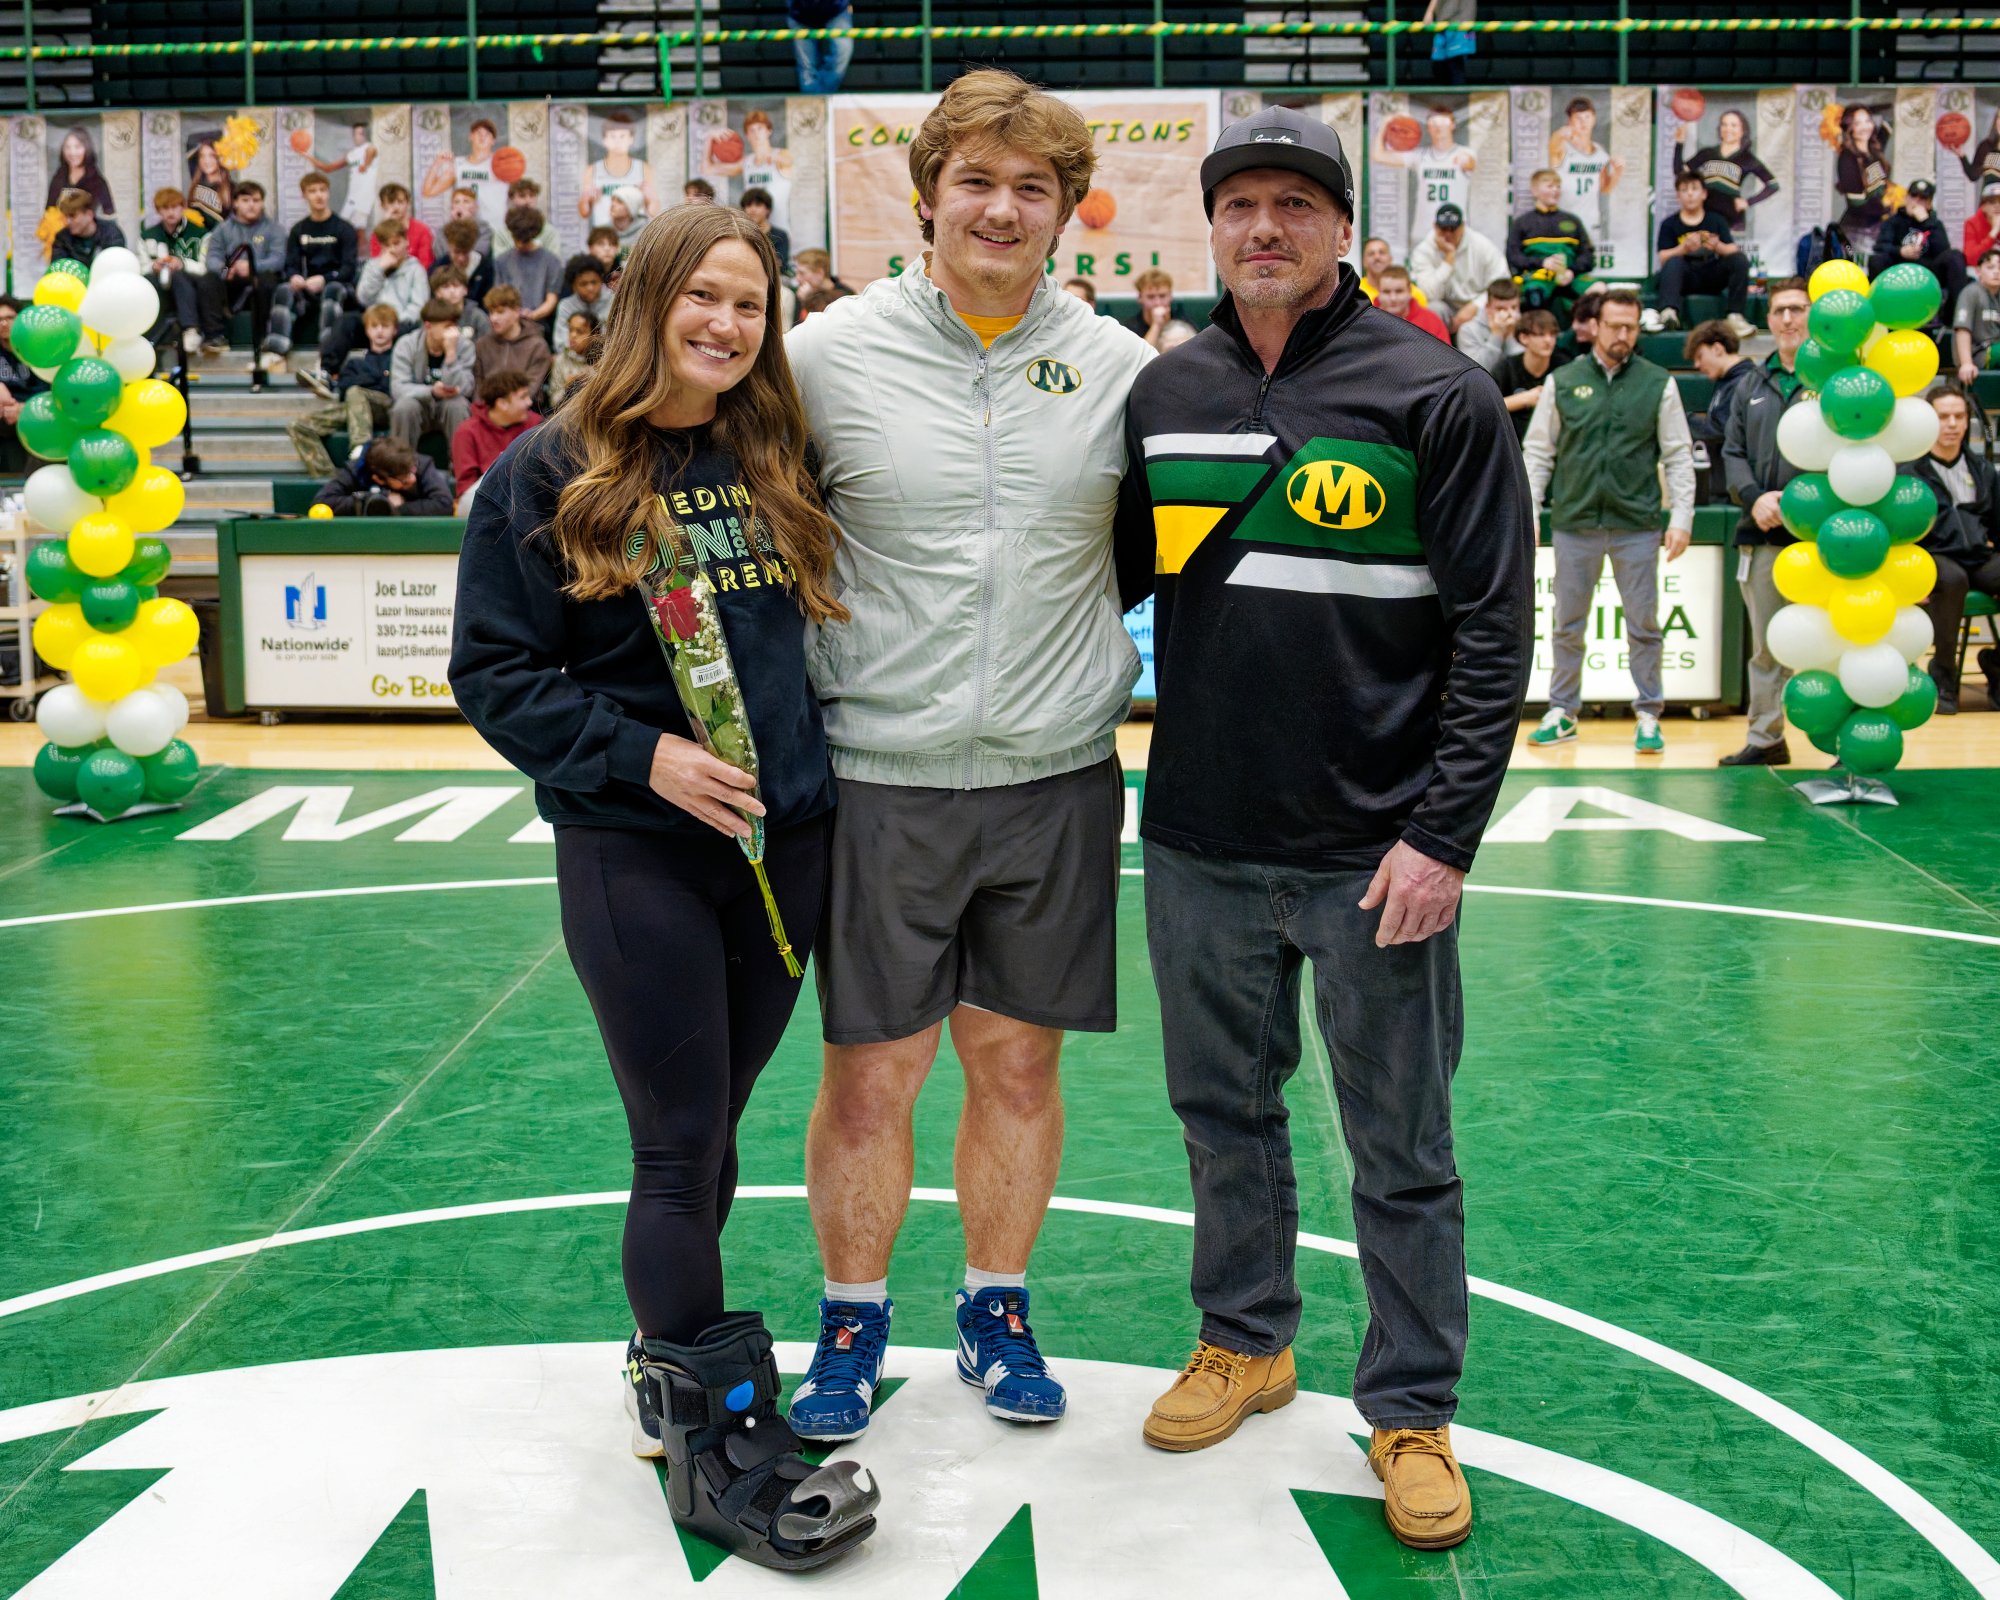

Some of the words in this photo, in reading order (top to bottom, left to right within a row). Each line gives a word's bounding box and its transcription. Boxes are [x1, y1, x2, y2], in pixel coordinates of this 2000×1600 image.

[1427, 184, 1449, 201] 20
[1034, 359, 1079, 394] M
[1290, 461, 1383, 529] M
[375, 580, 397, 596] Joe
[401, 581, 437, 596] Lazor
[376, 605, 401, 617] Lazor
[405, 605, 453, 617] Insurance
[377, 624, 448, 637] 330-722-4444
[261, 637, 350, 651] Nationwide
[371, 674, 403, 698] Go
